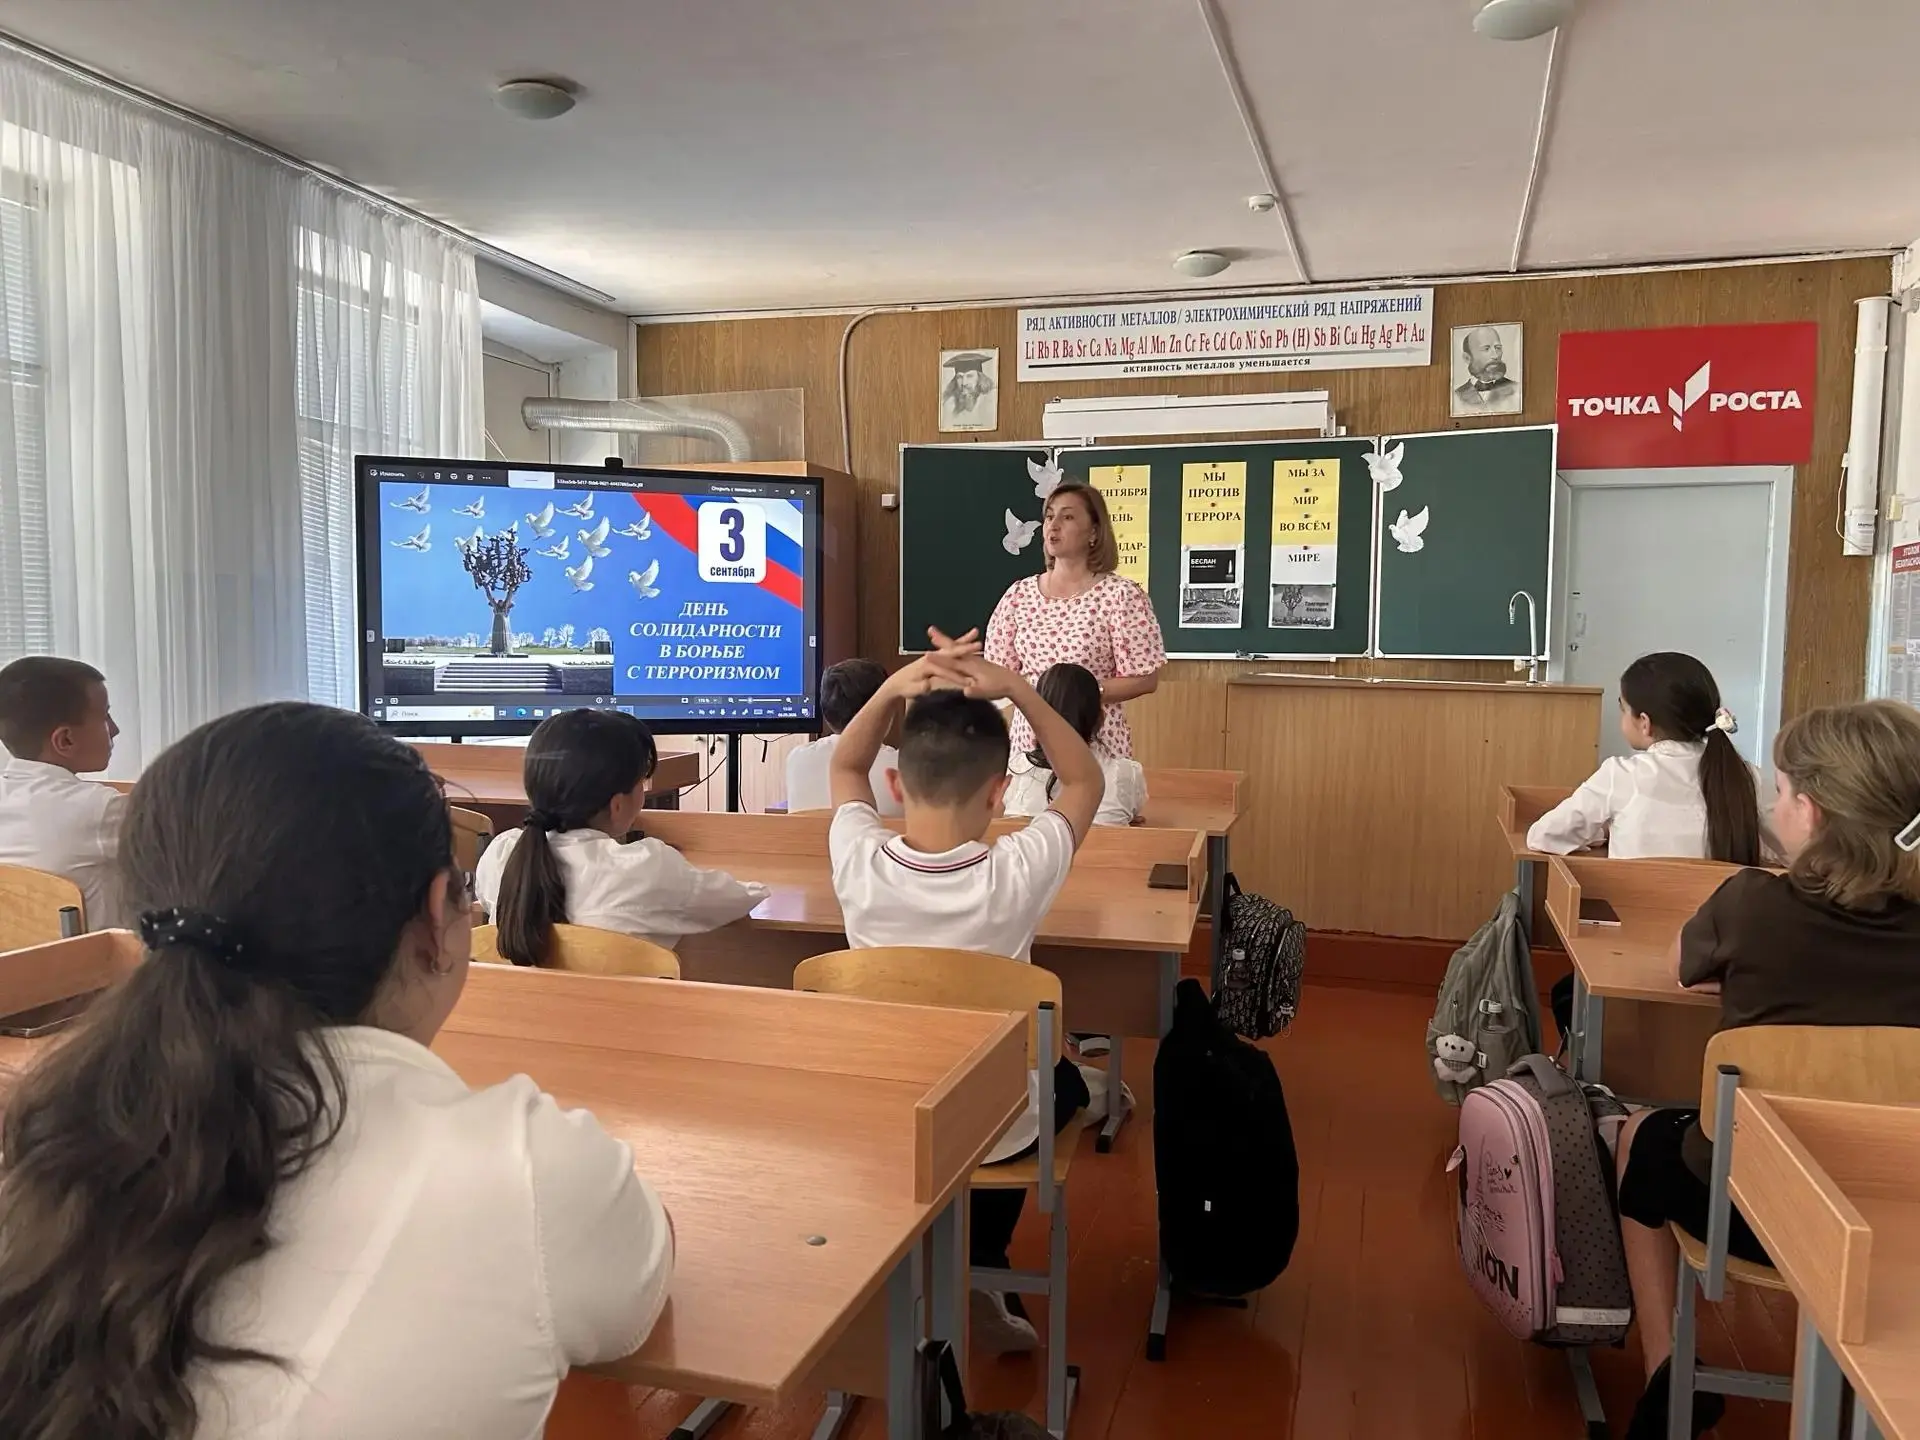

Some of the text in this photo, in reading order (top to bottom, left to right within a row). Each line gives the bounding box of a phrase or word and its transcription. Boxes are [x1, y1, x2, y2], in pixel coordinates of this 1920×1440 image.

[1026, 317, 1045, 331] РЯД
[1048, 313, 1116, 330] АКТИВНОСТИ
[1185, 301, 1309, 323] ЭЛЕКТРОХИМИЧЕСКИЙ
[1314, 302, 1335, 317] РЯД
[1340, 294, 1422, 315] НАПРЯЖЕНИЙ
[1025, 341, 1034, 359] Li
[1038, 341, 1049, 359] Rb
[1062, 340, 1074, 358] Ba
[1077, 339, 1087, 357] Sr
[1089, 338, 1101, 357] Ca
[1105, 338, 1117, 356] Na
[1120, 337, 1135, 360] Mg
[1137, 336, 1148, 354] Al
[1150, 335, 1166, 354] Mn
[1169, 334, 1181, 353] Zn
[1185, 333, 1196, 352] Cr
[1200, 333, 1210, 352] Fe
[1214, 332, 1226, 351] Cd
[1229, 331, 1242, 350] Co
[1245, 330, 1257, 349] Ni
[1260, 329, 1272, 349] Sn
[1276, 329, 1289, 348] Pb
[1292, 327, 1310, 351] (H)
[1314, 327, 1326, 346] Sb
[1330, 326, 1340, 346] Bi
[1344, 325, 1357, 345] Cu
[1361, 325, 1376, 349] Hg
[1378, 324, 1393, 348] Ag
[1396, 323, 1408, 342] Pt
[1410, 322, 1425, 342] Au
[1123, 358, 1311, 373] активность металлов уменьшается
[1568, 390, 1802, 417] ТОЧКА РОСТА
[1203, 471, 1225, 482] МЫ
[1288, 468, 1325, 478] МЫ ЗА
[1116, 475, 1122, 483] 3
[1099, 487, 1147, 497] ЕНТЯБРЯ
[1188, 488, 1240, 498] ПРОТИВ
[1293, 496, 1319, 505] МИР
[1109, 513, 1133, 522] ЕНЬ
[1185, 511, 1241, 522] ТЕРРОРА
[1279, 520, 1330, 531] ВО ВСЁМ
[720, 508, 745, 562] 3
[1288, 553, 1320, 562] МИРЕ
[710, 566, 755, 578] сентября
[679, 602, 729, 618] ДЕНЬ
[629, 622, 782, 639] СОЛИДАРНОСТИ
[659, 644, 745, 659] В БОРЬБЕ
[627, 665, 781, 680] С ТЕРРОРИЗМОМ
